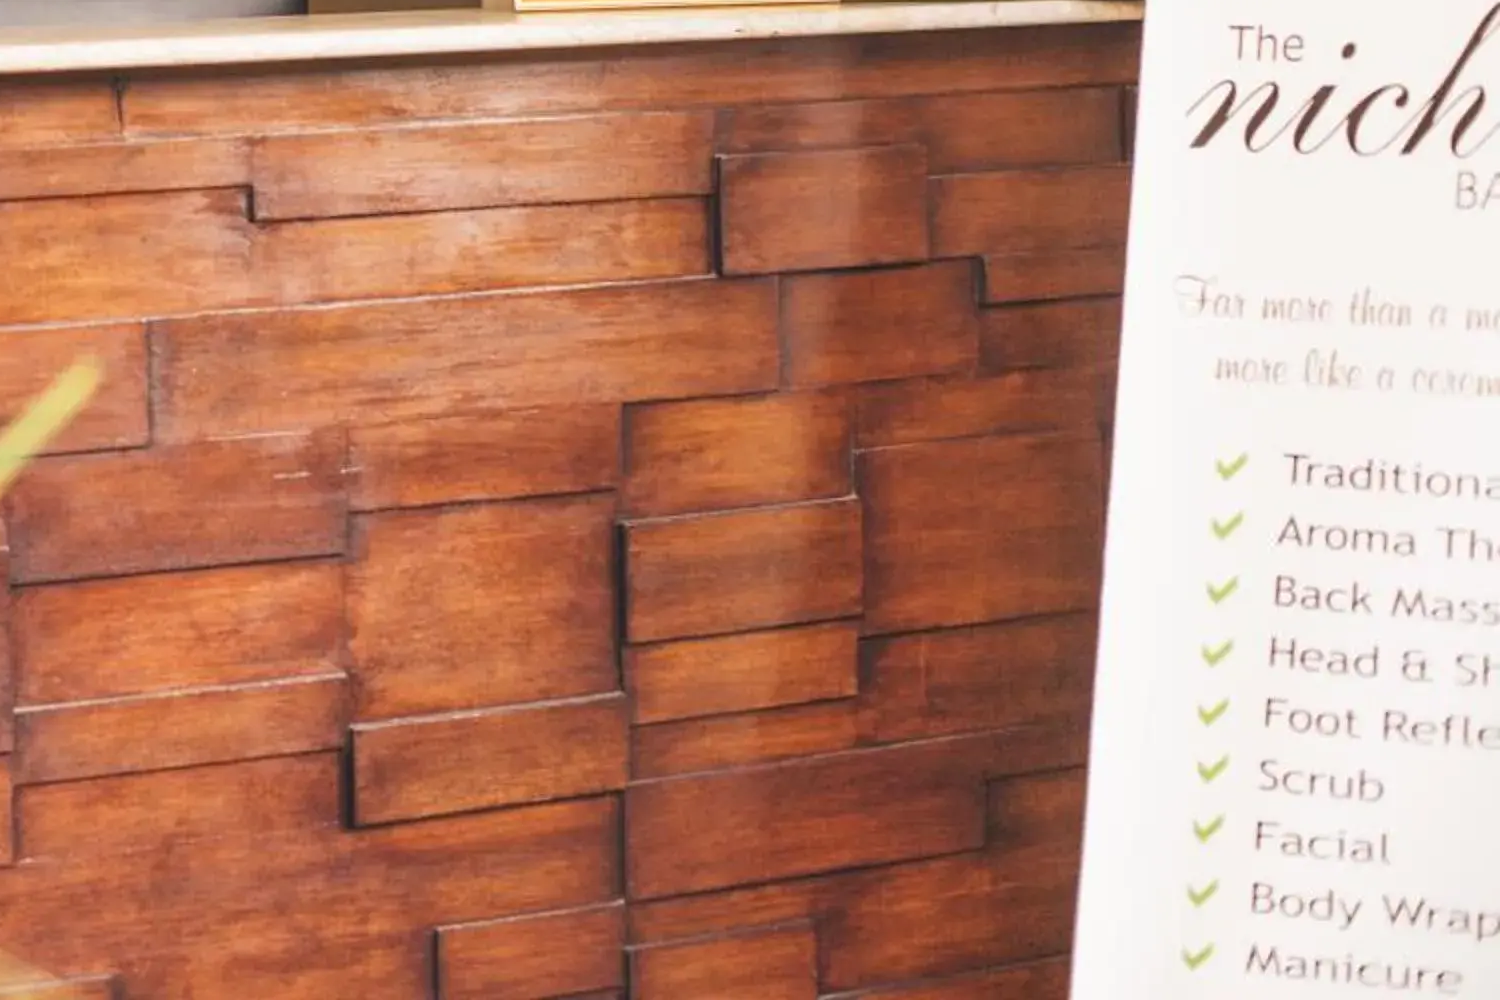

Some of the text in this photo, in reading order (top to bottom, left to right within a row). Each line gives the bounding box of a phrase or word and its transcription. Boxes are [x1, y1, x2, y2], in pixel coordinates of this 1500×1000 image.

[1227, 23, 1306, 63] The
[1261, 296, 1333, 322] more
[1350, 285, 1412, 327] than
[1429, 303, 1448, 328] a
[1214, 357, 1288, 386] more
[1303, 347, 1363, 391] like
[1376, 365, 1395, 392] a
[1276, 515, 1417, 558] Aroma
[1273, 574, 1500, 626] Back Mass
[1268, 636, 1380, 680] Head
[1401, 650, 1434, 685] &
[1263, 697, 1500, 751] Foot Refle
[1258, 758, 1386, 804] Scrub
[1254, 820, 1392, 865] Facial
[1250, 881, 1500, 941] Body Wrap
[1244, 943, 1465, 996] Manicure
